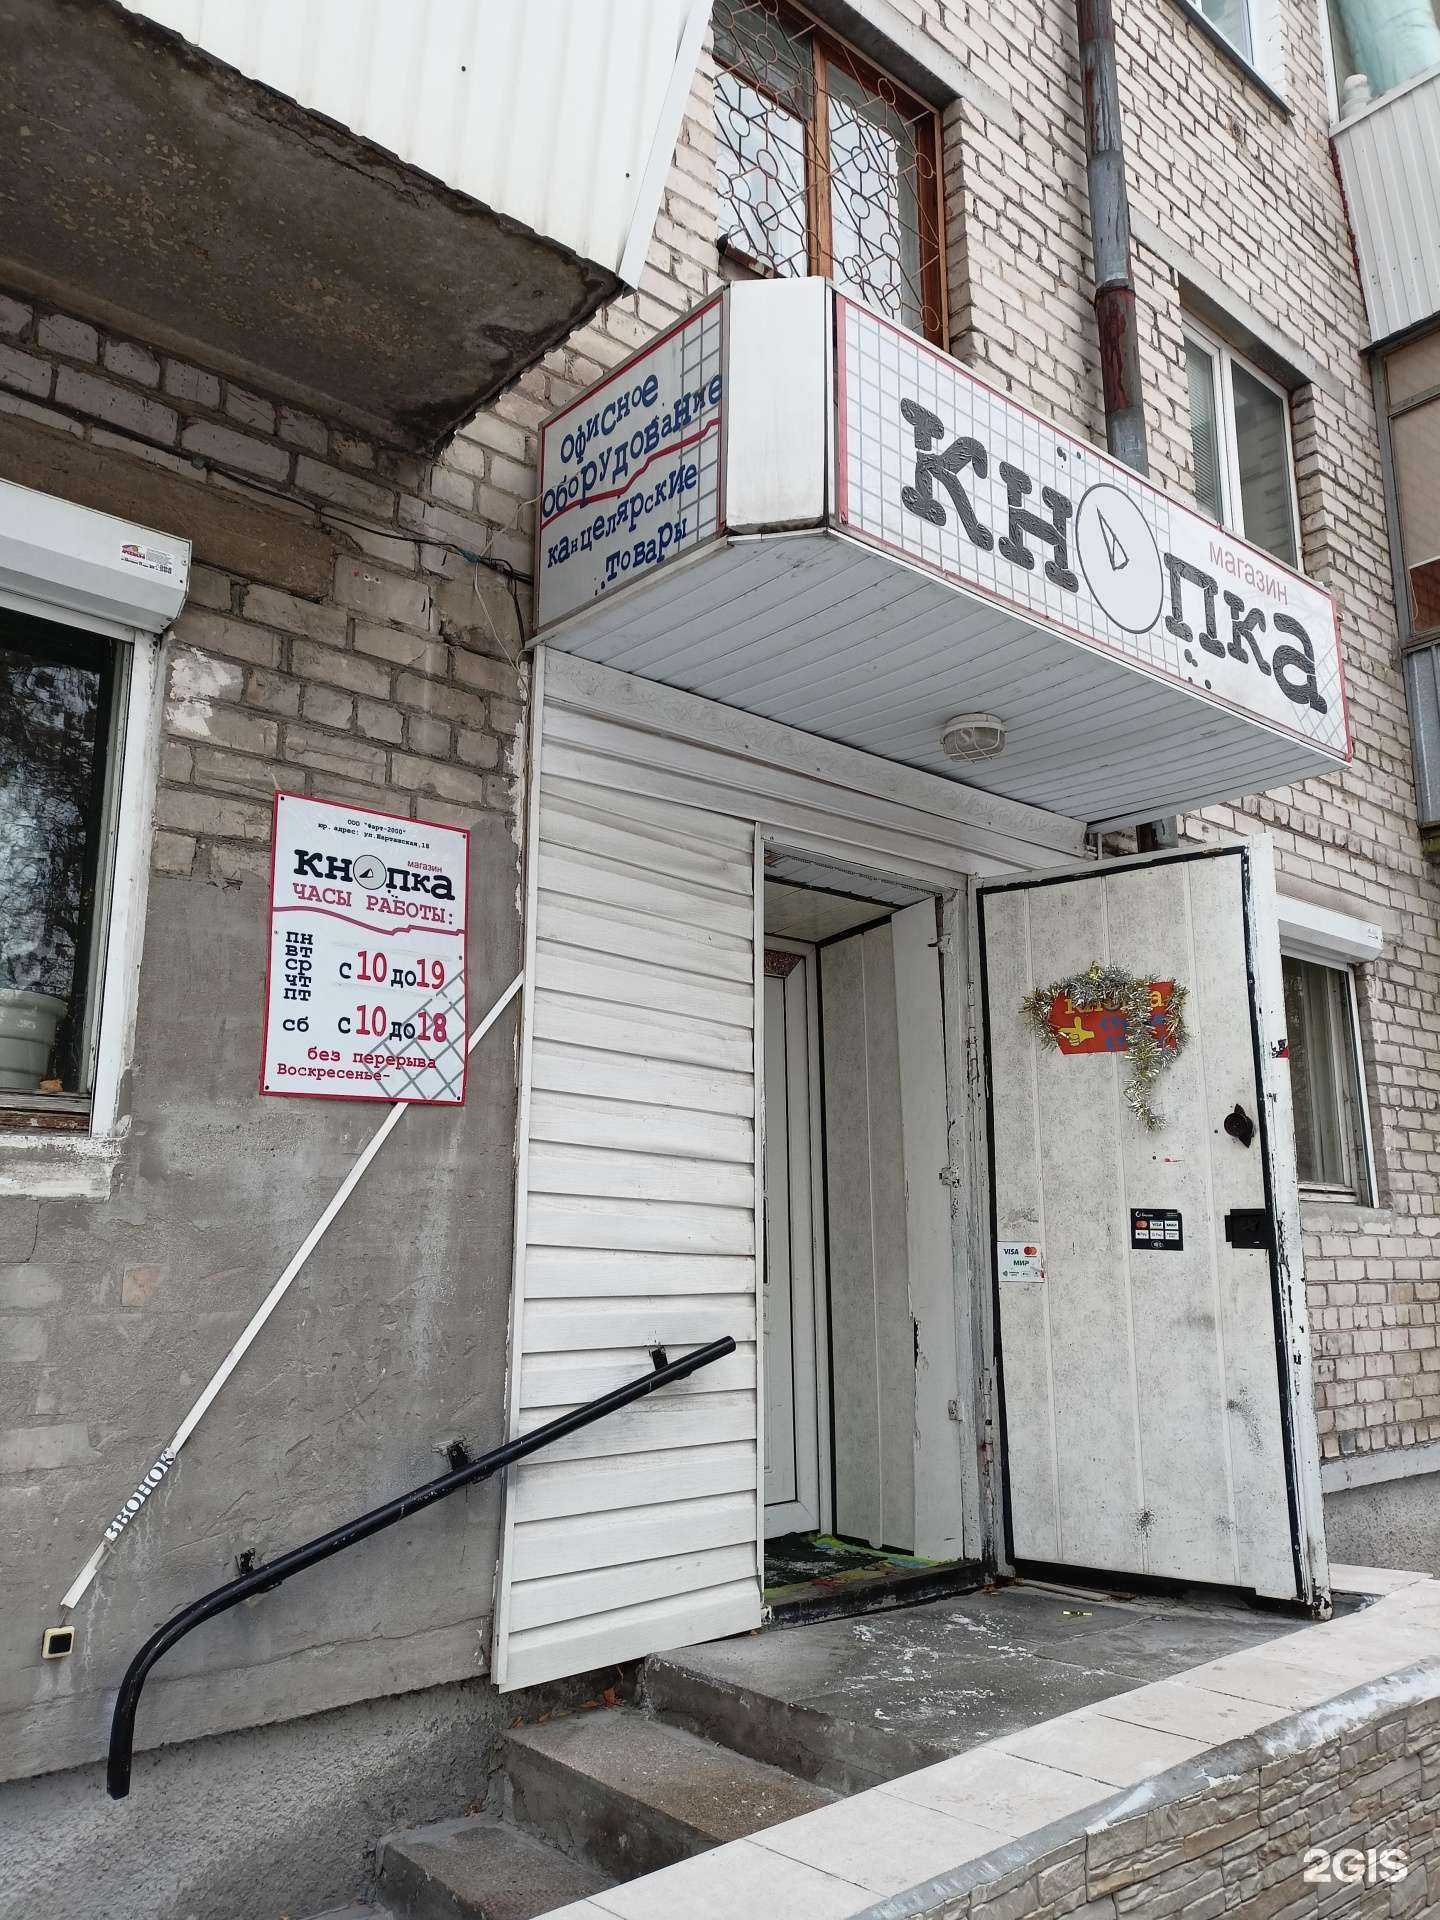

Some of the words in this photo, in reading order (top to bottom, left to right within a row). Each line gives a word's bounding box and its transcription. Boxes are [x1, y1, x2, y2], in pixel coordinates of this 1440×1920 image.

[1208, 541, 1289, 606] магазин
[407, 860, 443, 873] магазин
[292, 882, 352, 907] ЧАСЫ
[366, 895, 453, 925] РАБОТЫ:
[357, 950, 388, 983] 10
[282, 1016, 309, 1033] сб
[355, 1004, 387, 1037] 10
[307, 1047, 341, 1063] без
[352, 1052, 437, 1069] перерыва
[1013, 1259, 1030, 1267] МИР
[104, 1447, 176, 1541] ЗВОНОК
